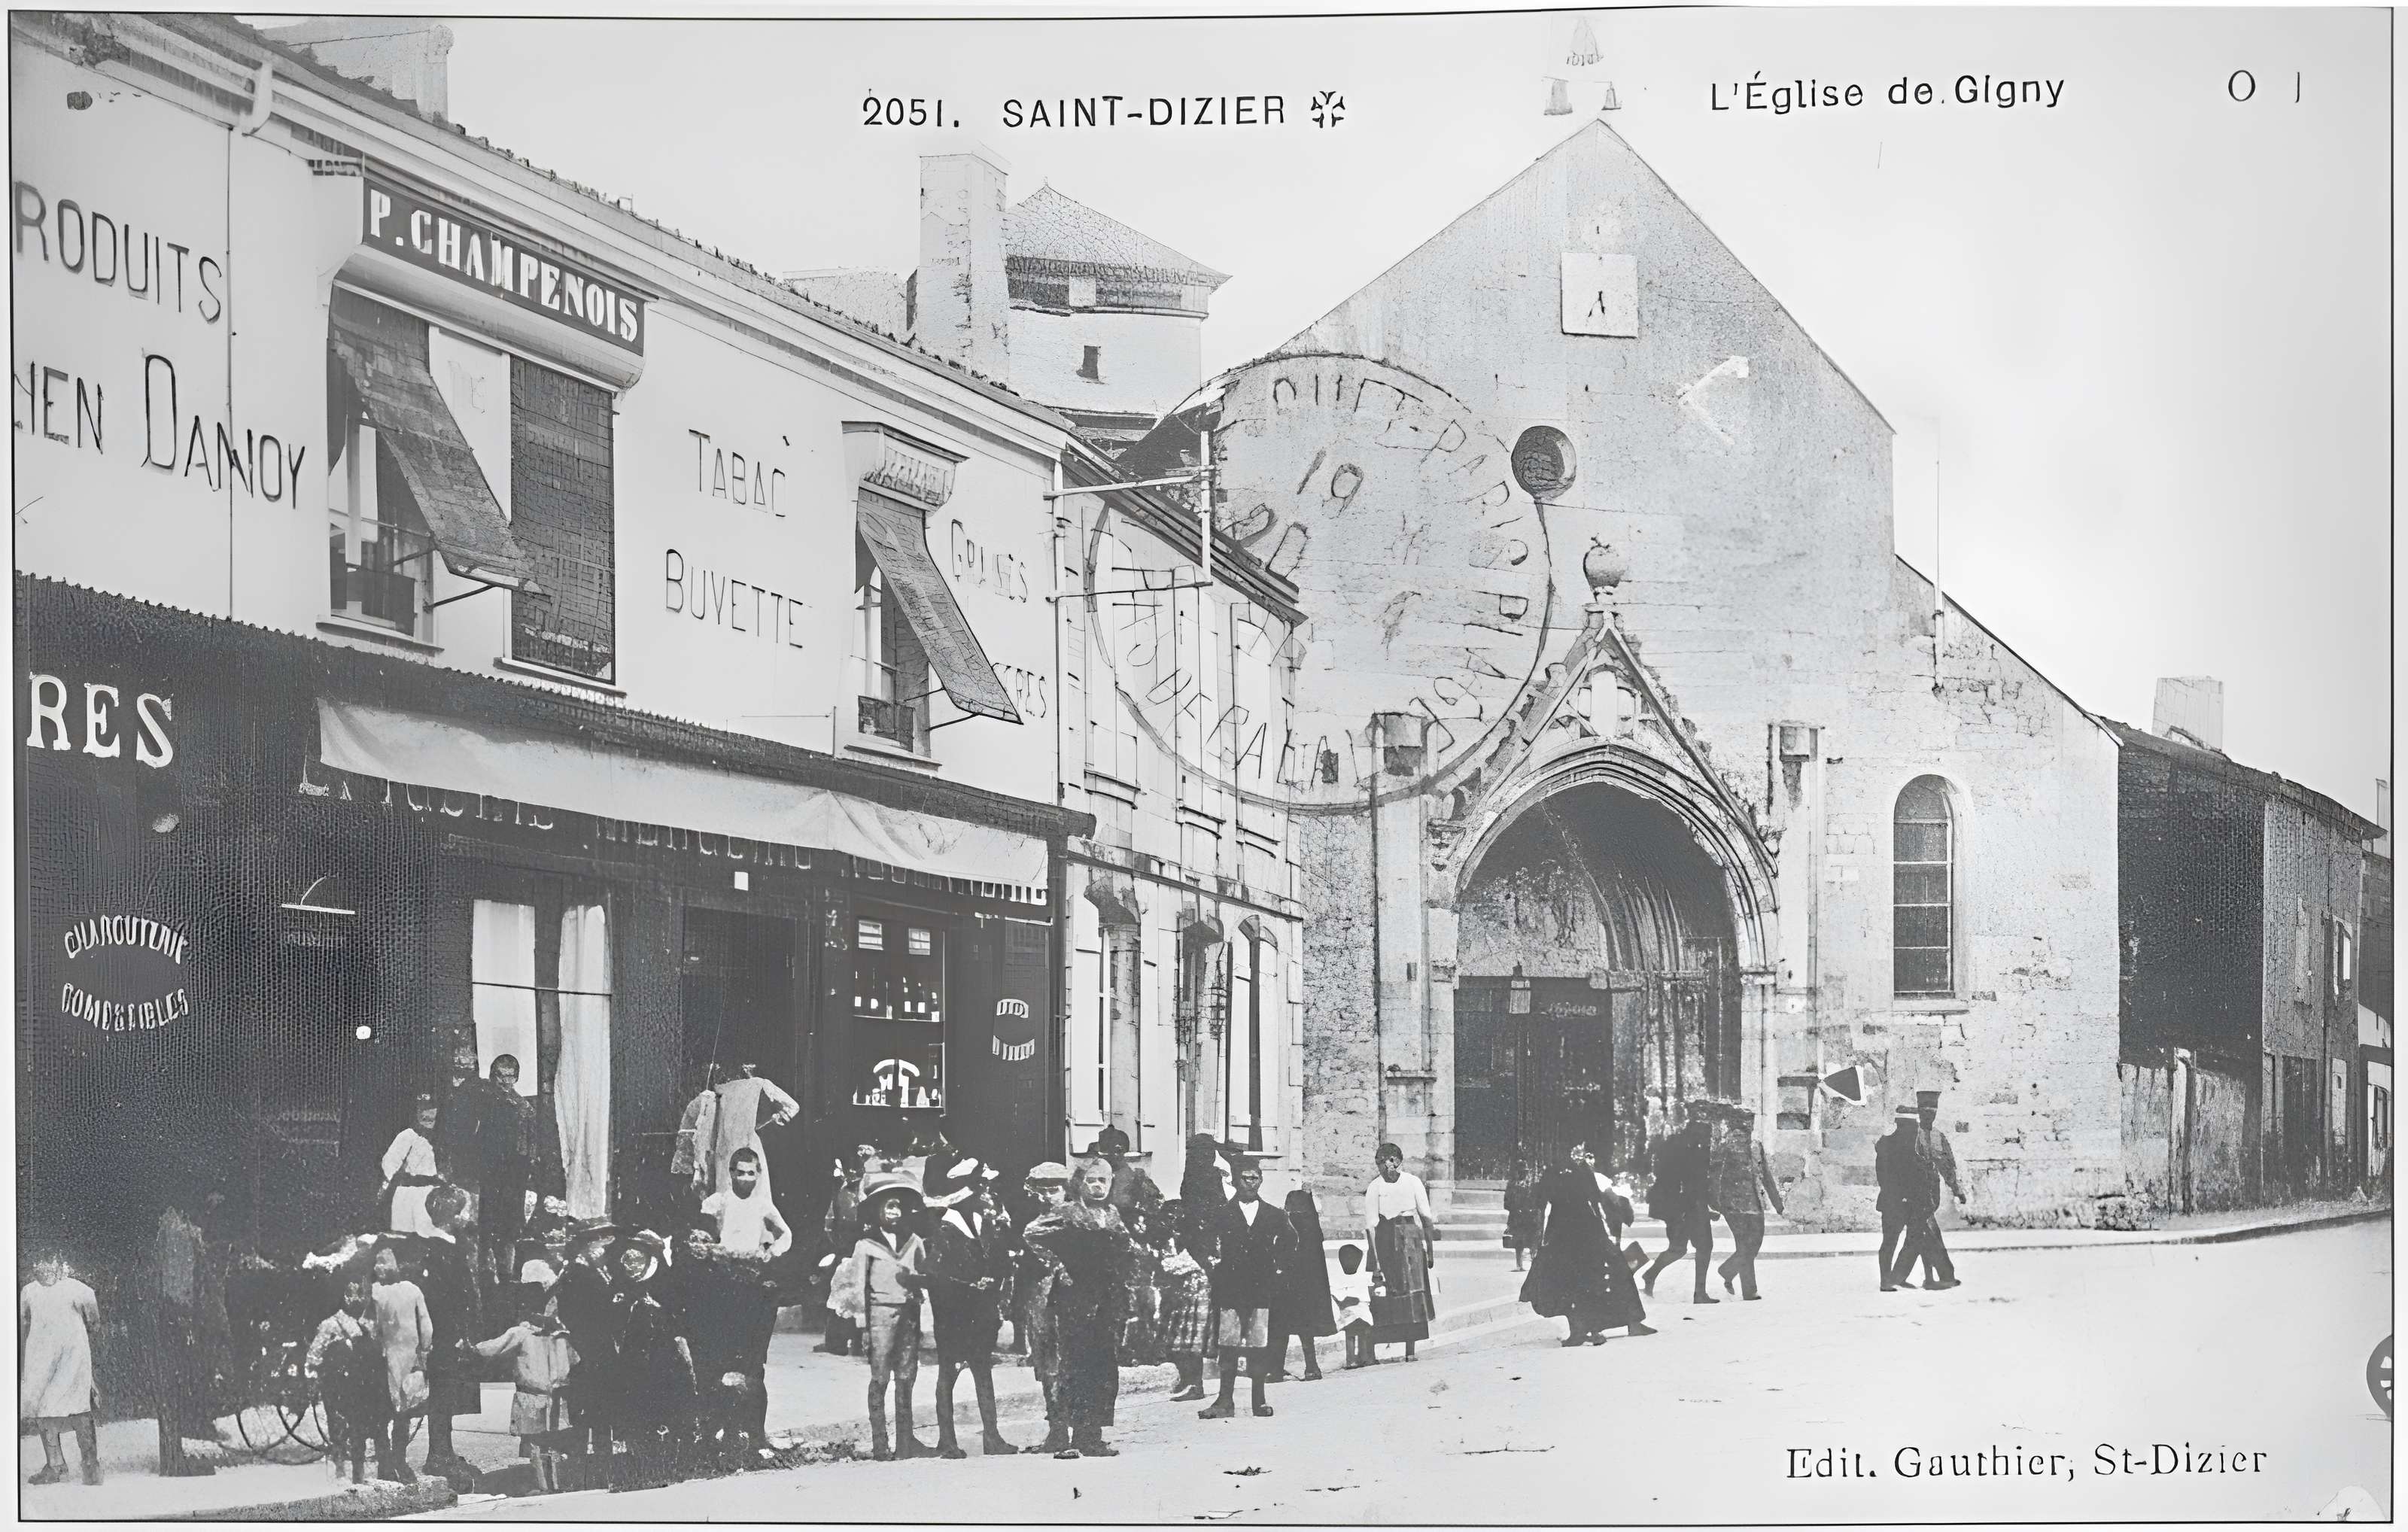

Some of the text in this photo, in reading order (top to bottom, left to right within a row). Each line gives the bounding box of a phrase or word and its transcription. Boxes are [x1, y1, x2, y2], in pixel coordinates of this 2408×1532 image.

[14, 181, 222, 325] RODUITS
[411, 209, 638, 342] CHAMPENOIS
[26, 671, 174, 769] RES
